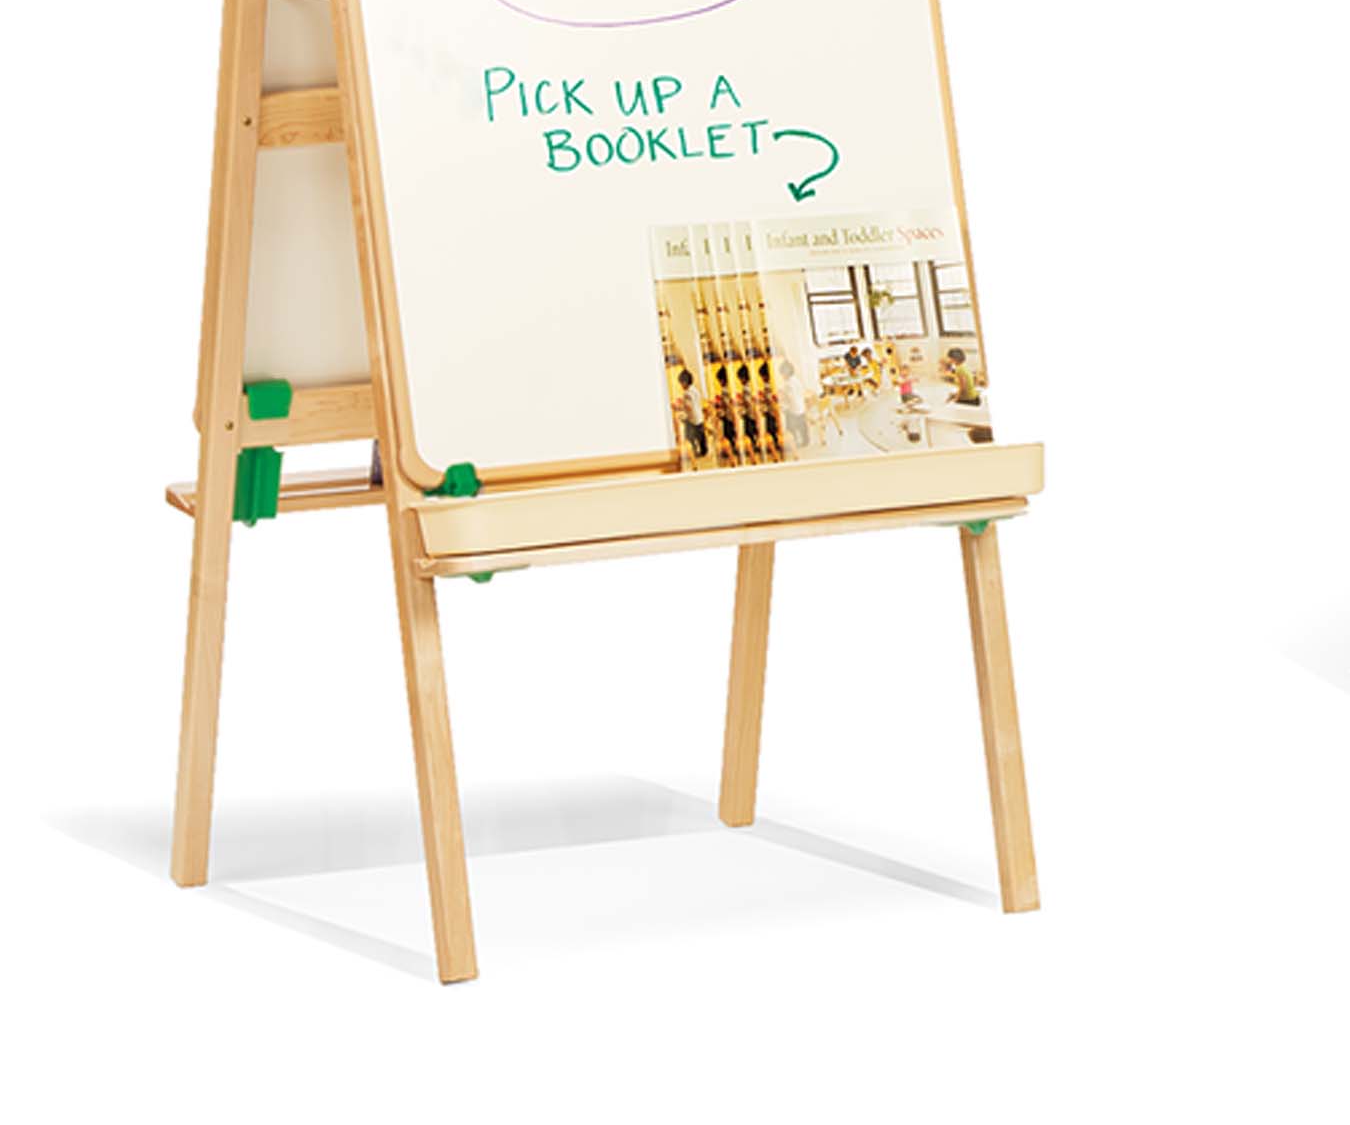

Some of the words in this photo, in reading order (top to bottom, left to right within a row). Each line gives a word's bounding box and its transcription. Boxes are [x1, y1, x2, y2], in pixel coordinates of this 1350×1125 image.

[484, 66, 594, 122] PICK
[615, 75, 682, 117] UP
[709, 75, 742, 110] A
[543, 119, 770, 173] BOOKLET
[768, 230, 811, 250] Infant
[813, 228, 839, 247] and
[842, 225, 895, 245] Toddler
